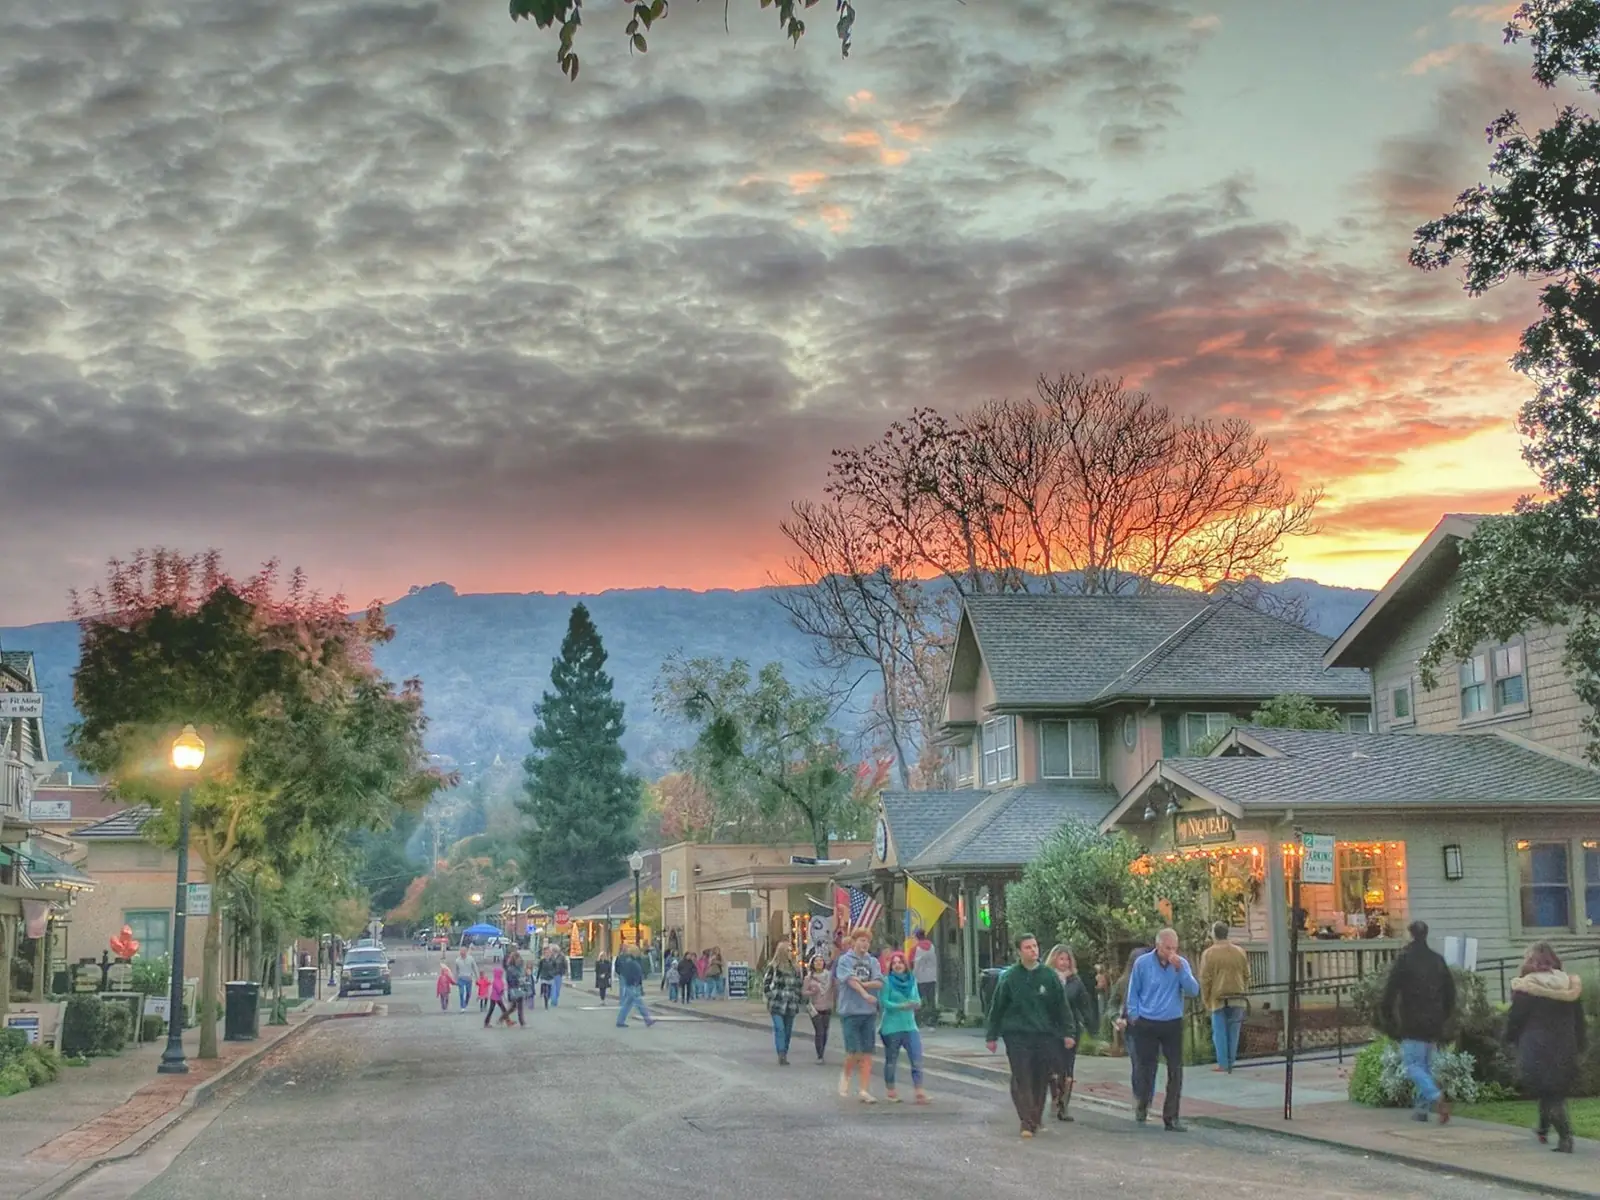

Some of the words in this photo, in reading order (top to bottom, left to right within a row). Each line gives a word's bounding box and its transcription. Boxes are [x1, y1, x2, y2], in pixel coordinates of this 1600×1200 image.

[10, 696, 20, 704] Fit
[21, 696, 41, 704] Mind
[19, 705, 37, 713] Body
[1304, 835, 1313, 847] 2
[1305, 850, 1332, 861] PARKING
